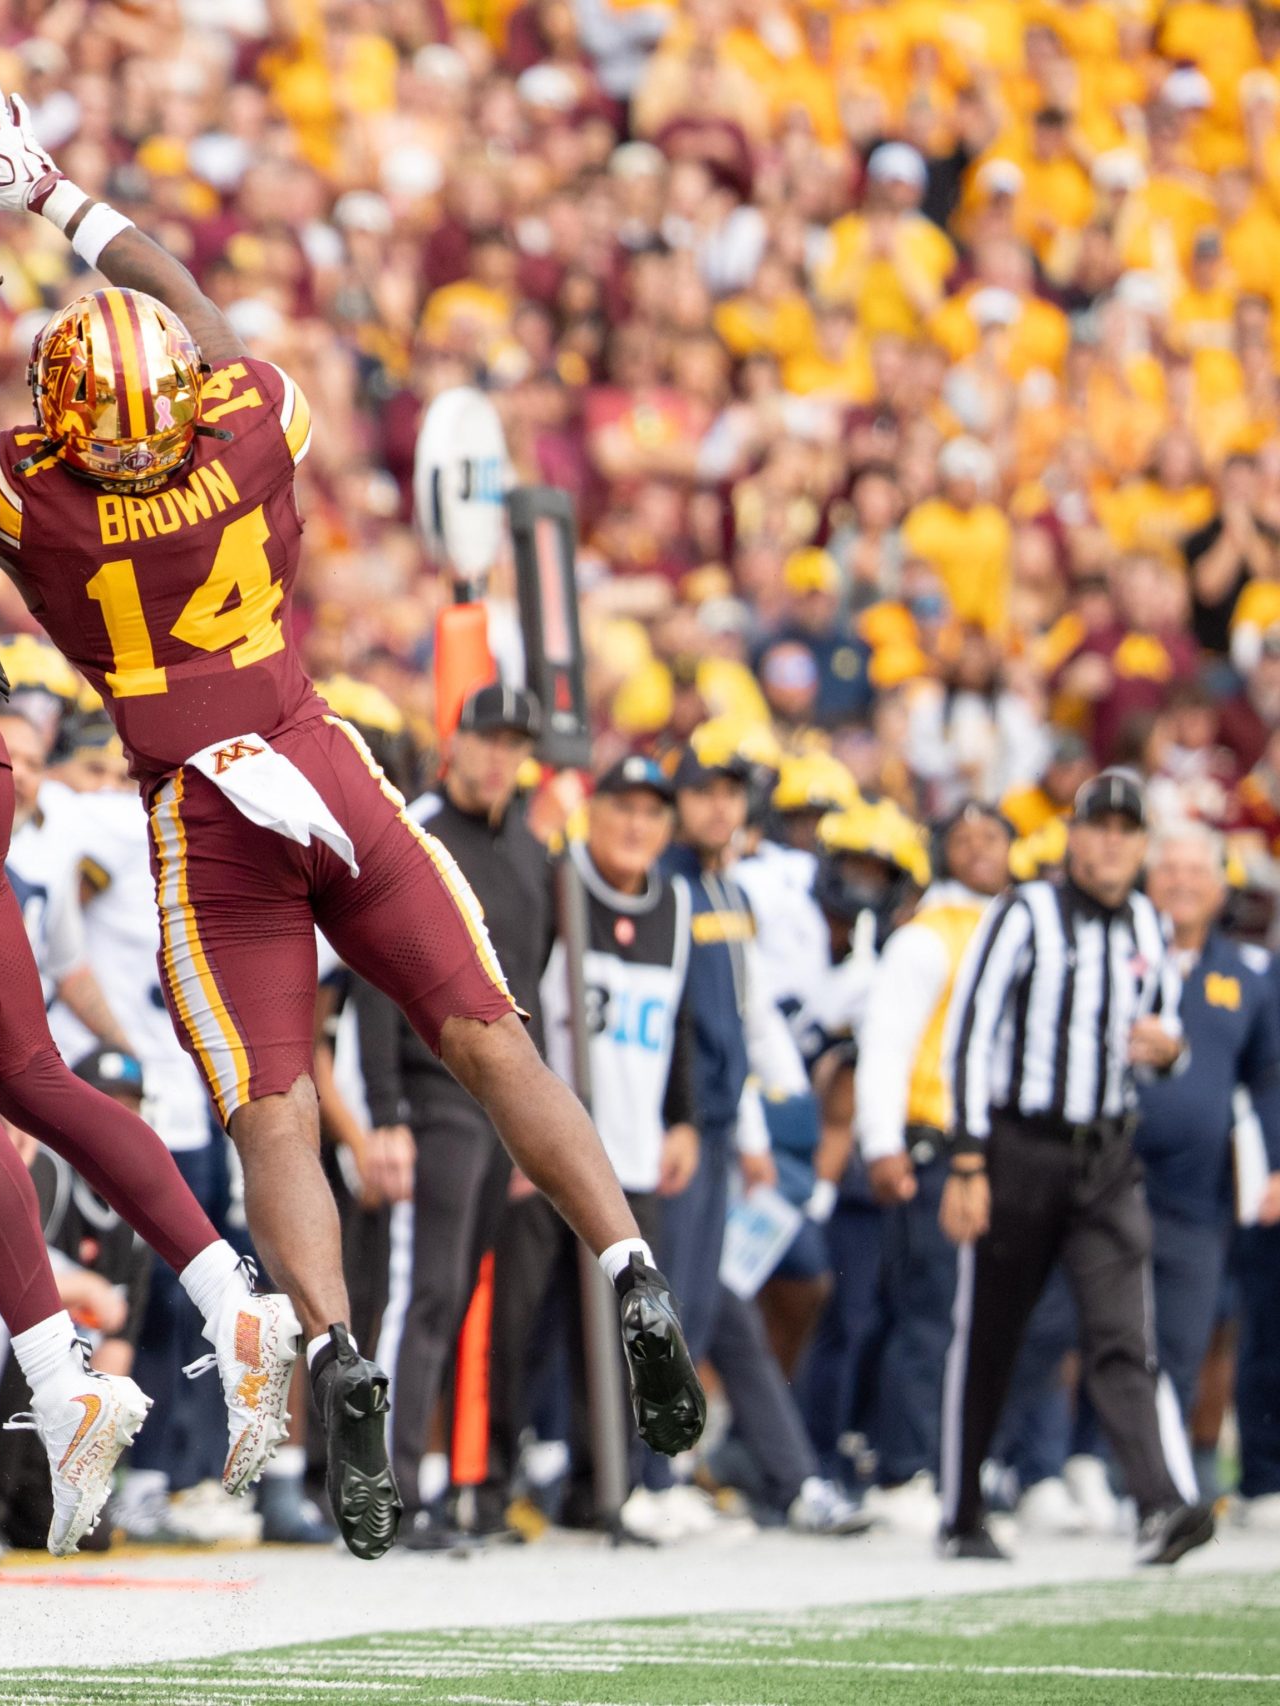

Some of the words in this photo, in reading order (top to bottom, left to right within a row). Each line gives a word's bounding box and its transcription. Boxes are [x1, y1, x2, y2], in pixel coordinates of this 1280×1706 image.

[201, 362, 263, 423] 14
[97, 459, 240, 544] BROWN
[86, 504, 285, 698] 14
